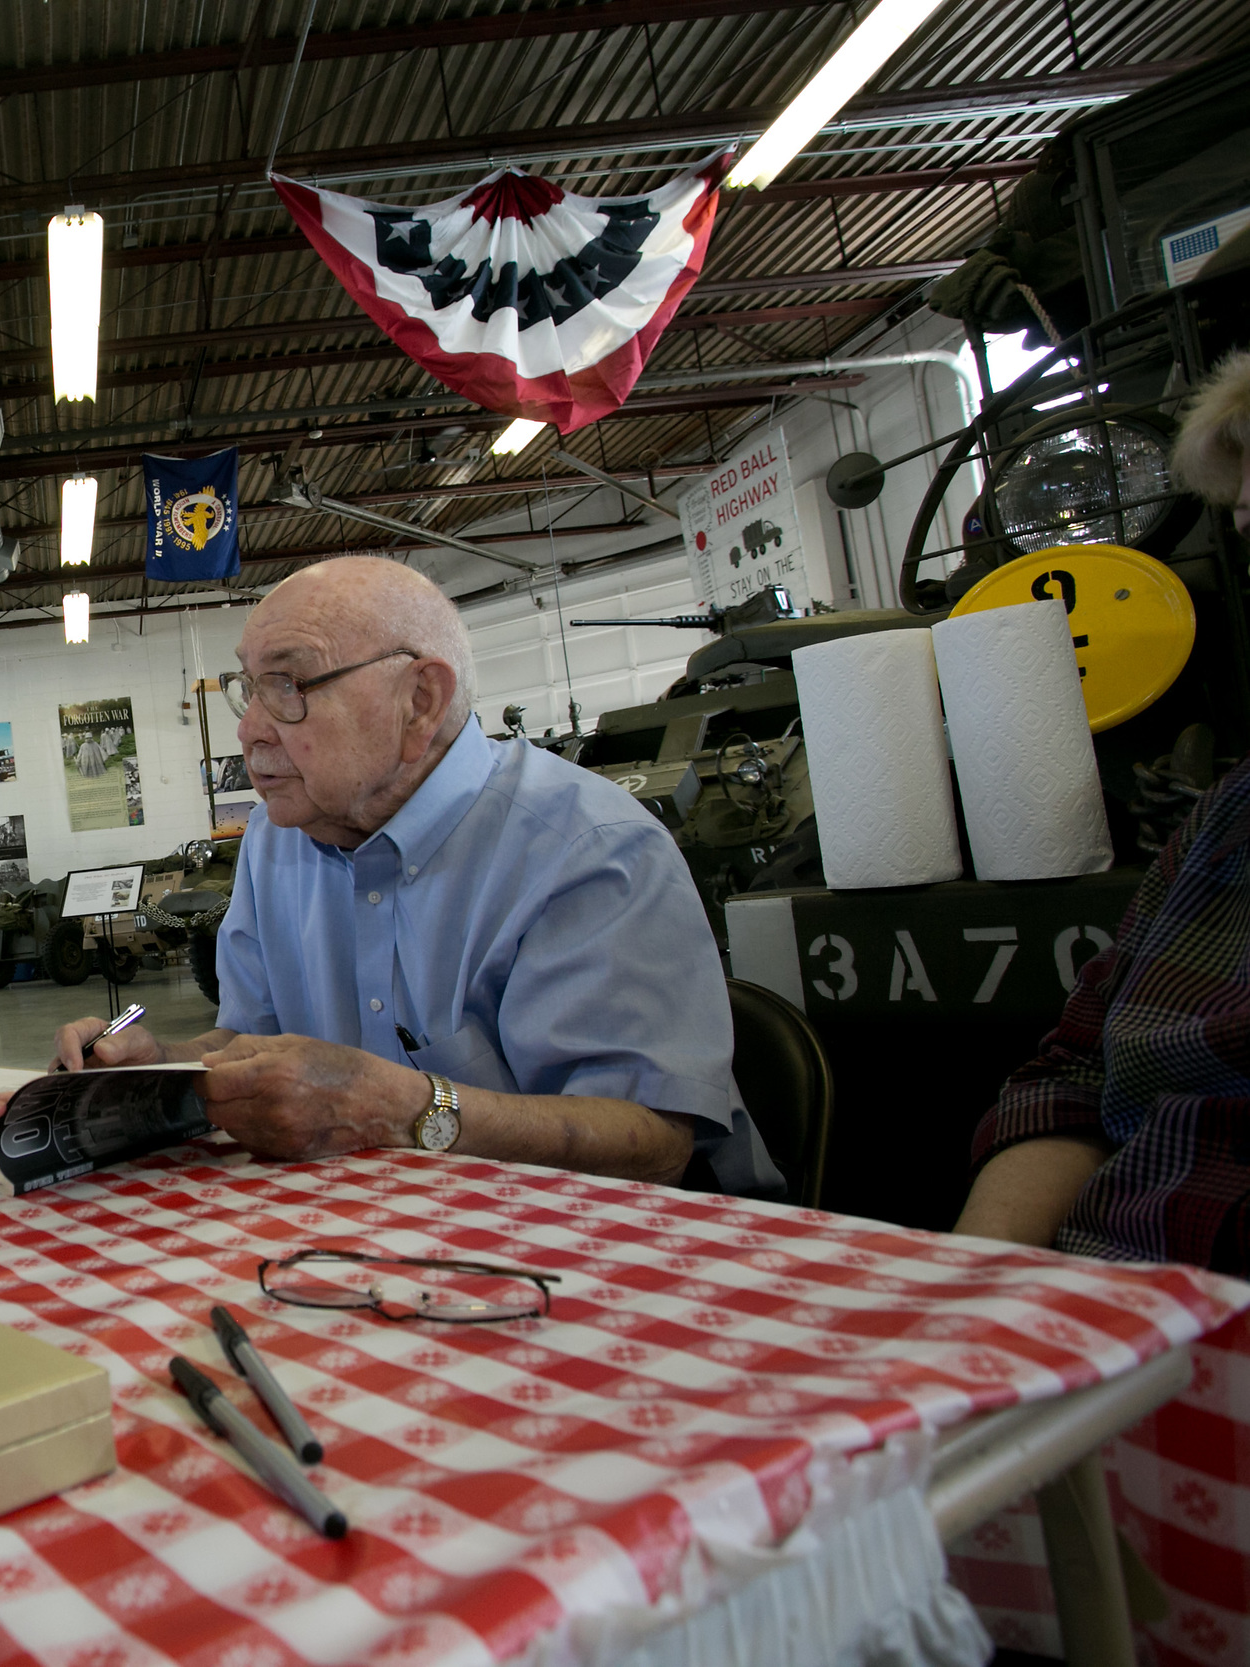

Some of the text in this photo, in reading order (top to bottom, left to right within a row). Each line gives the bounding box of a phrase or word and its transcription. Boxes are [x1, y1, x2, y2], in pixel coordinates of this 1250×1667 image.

[710, 444, 778, 499] RED BALL
[152, 479, 161, 517] WORLD
[716, 472, 779, 527] HIGHWAY
[155, 520, 163, 546] WAR
[173, 536, 191, 551] 1995
[730, 575, 752, 599] STAY
[756, 566, 770, 586] ON
[775, 554, 795, 577] THE
[63, 709, 130, 726] FORGOTTEN WAR
